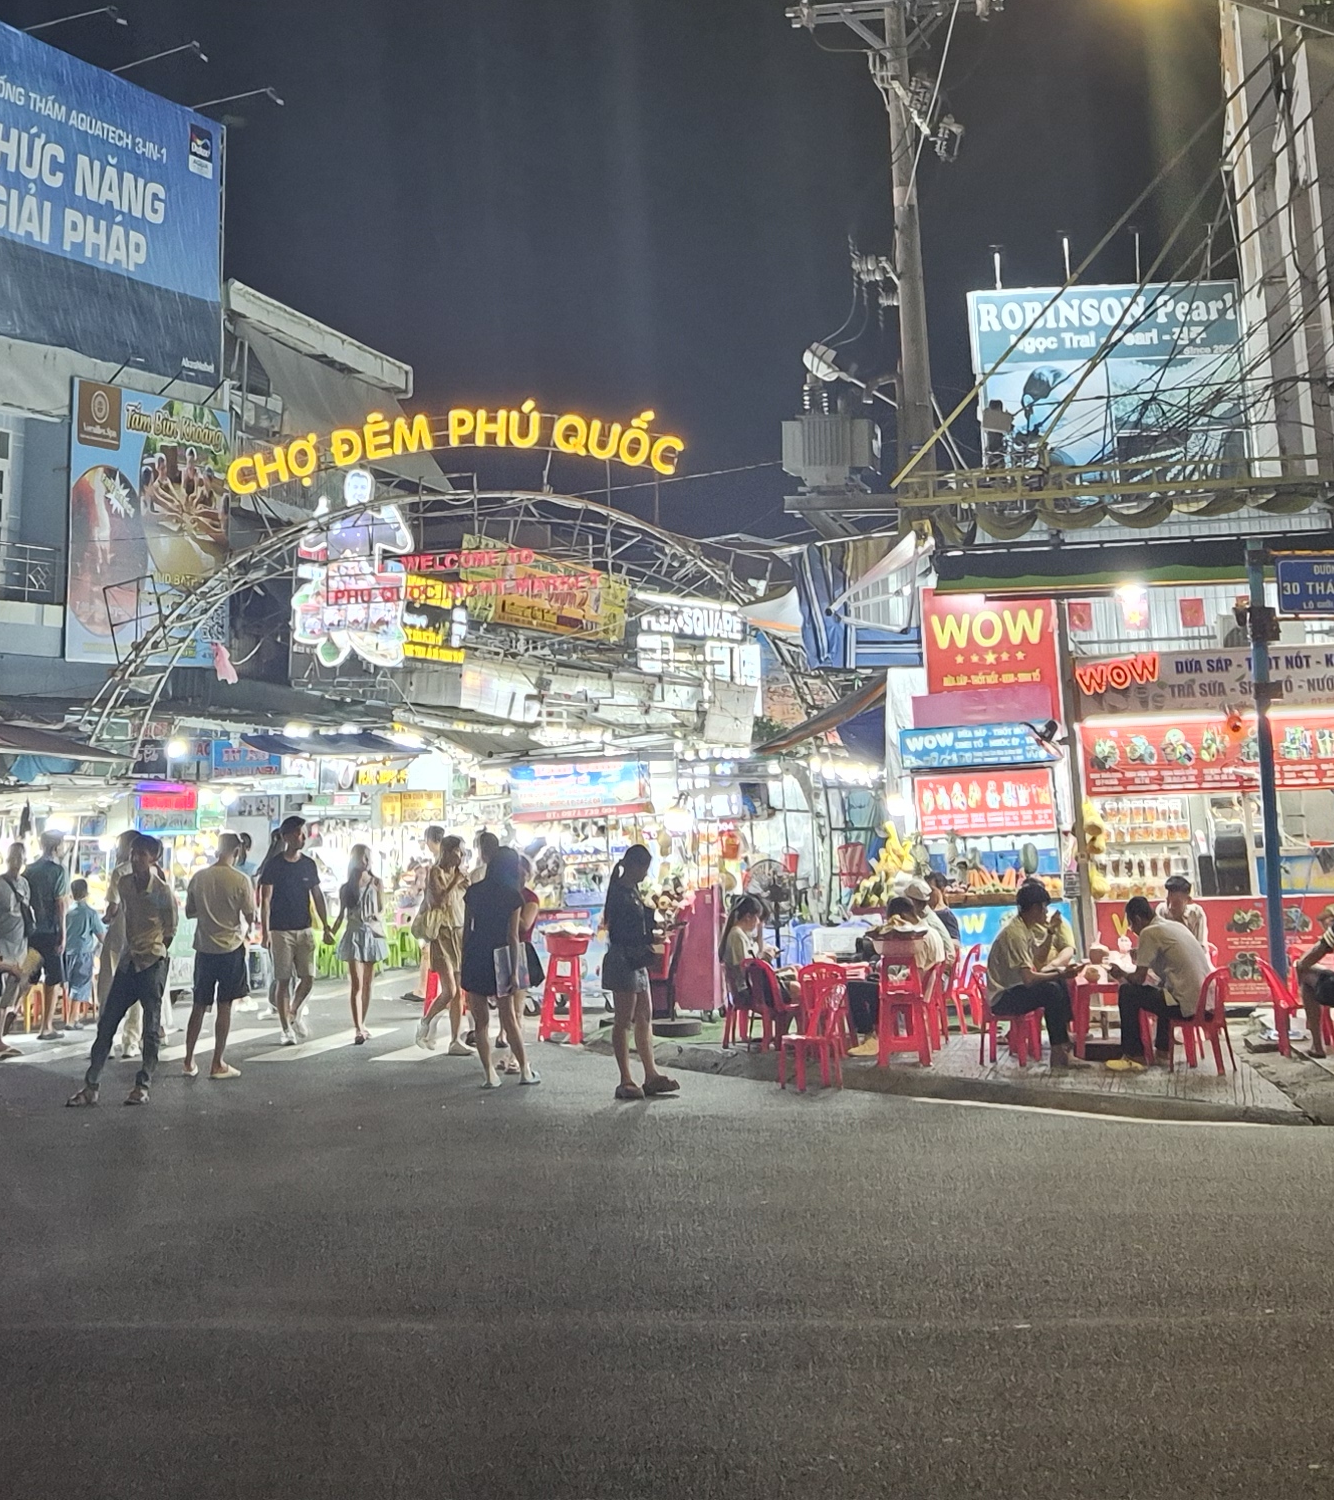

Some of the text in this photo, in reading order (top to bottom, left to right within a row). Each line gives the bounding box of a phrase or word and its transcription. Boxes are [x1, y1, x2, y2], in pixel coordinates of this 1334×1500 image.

[29, 92, 66, 123] THẤM
[69, 109, 132, 151] AQUATECH
[135, 136, 167, 164] 3-IN-1
[75, 154, 166, 225] NĂNG
[63, 207, 147, 272] PHÁP
[978, 291, 1237, 333] ROBINSON Pearl
[226, 396, 686, 497] CHỢ ĐÊM PHÚ QUỐC
[400, 549, 501, 572] WELCOME
[1283, 582, 1301, 595] 30
[930, 609, 1043, 650] WOW
[1074, 651, 1160, 696] WOW
[1175, 657, 1203, 674] DỪA
[1206, 655, 1233, 672] SÁP
[1285, 651, 1311, 669] NỐT
[1199, 678, 1227, 696] SỮA
[906, 731, 954, 752] WOW
